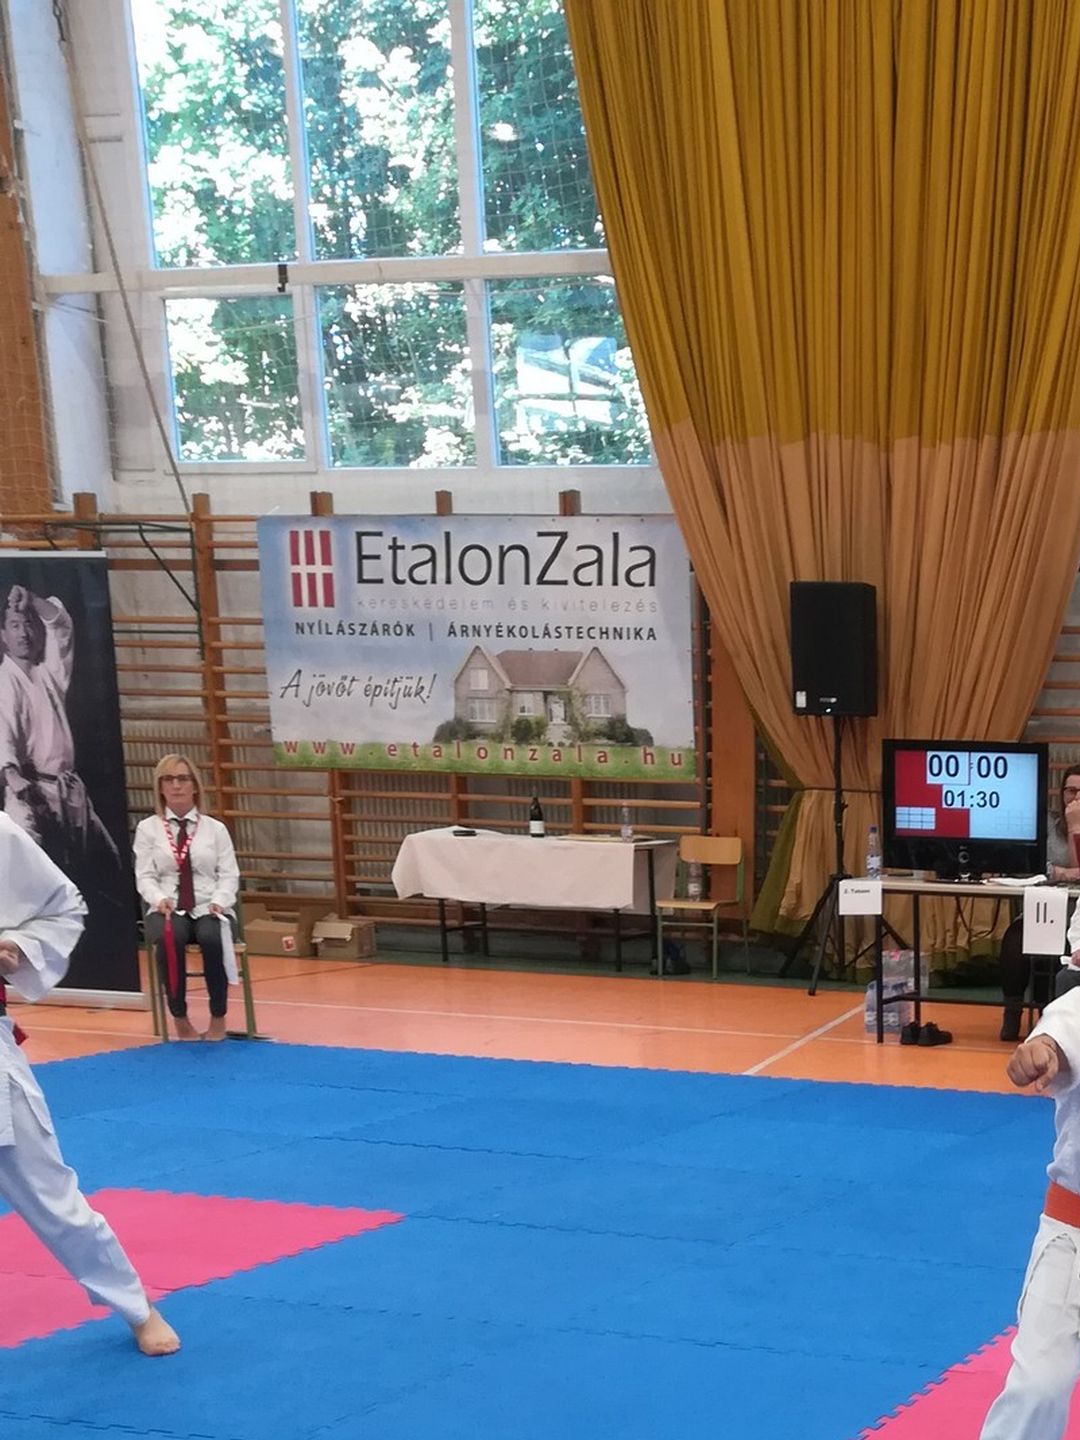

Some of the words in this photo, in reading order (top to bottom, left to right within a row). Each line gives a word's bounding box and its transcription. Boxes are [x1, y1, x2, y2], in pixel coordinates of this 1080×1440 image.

[355, 531, 657, 588] EtalonZala
[295, 619, 416, 638] NYÍLÁSZÁRÓK
[447, 621, 658, 641] ÁRNYÉKOLÁSTECHNIKA
[280, 668, 302, 698] A
[284, 739, 684, 767] www.etalonzala.hu
[944, 790, 1001, 809] 01:30
